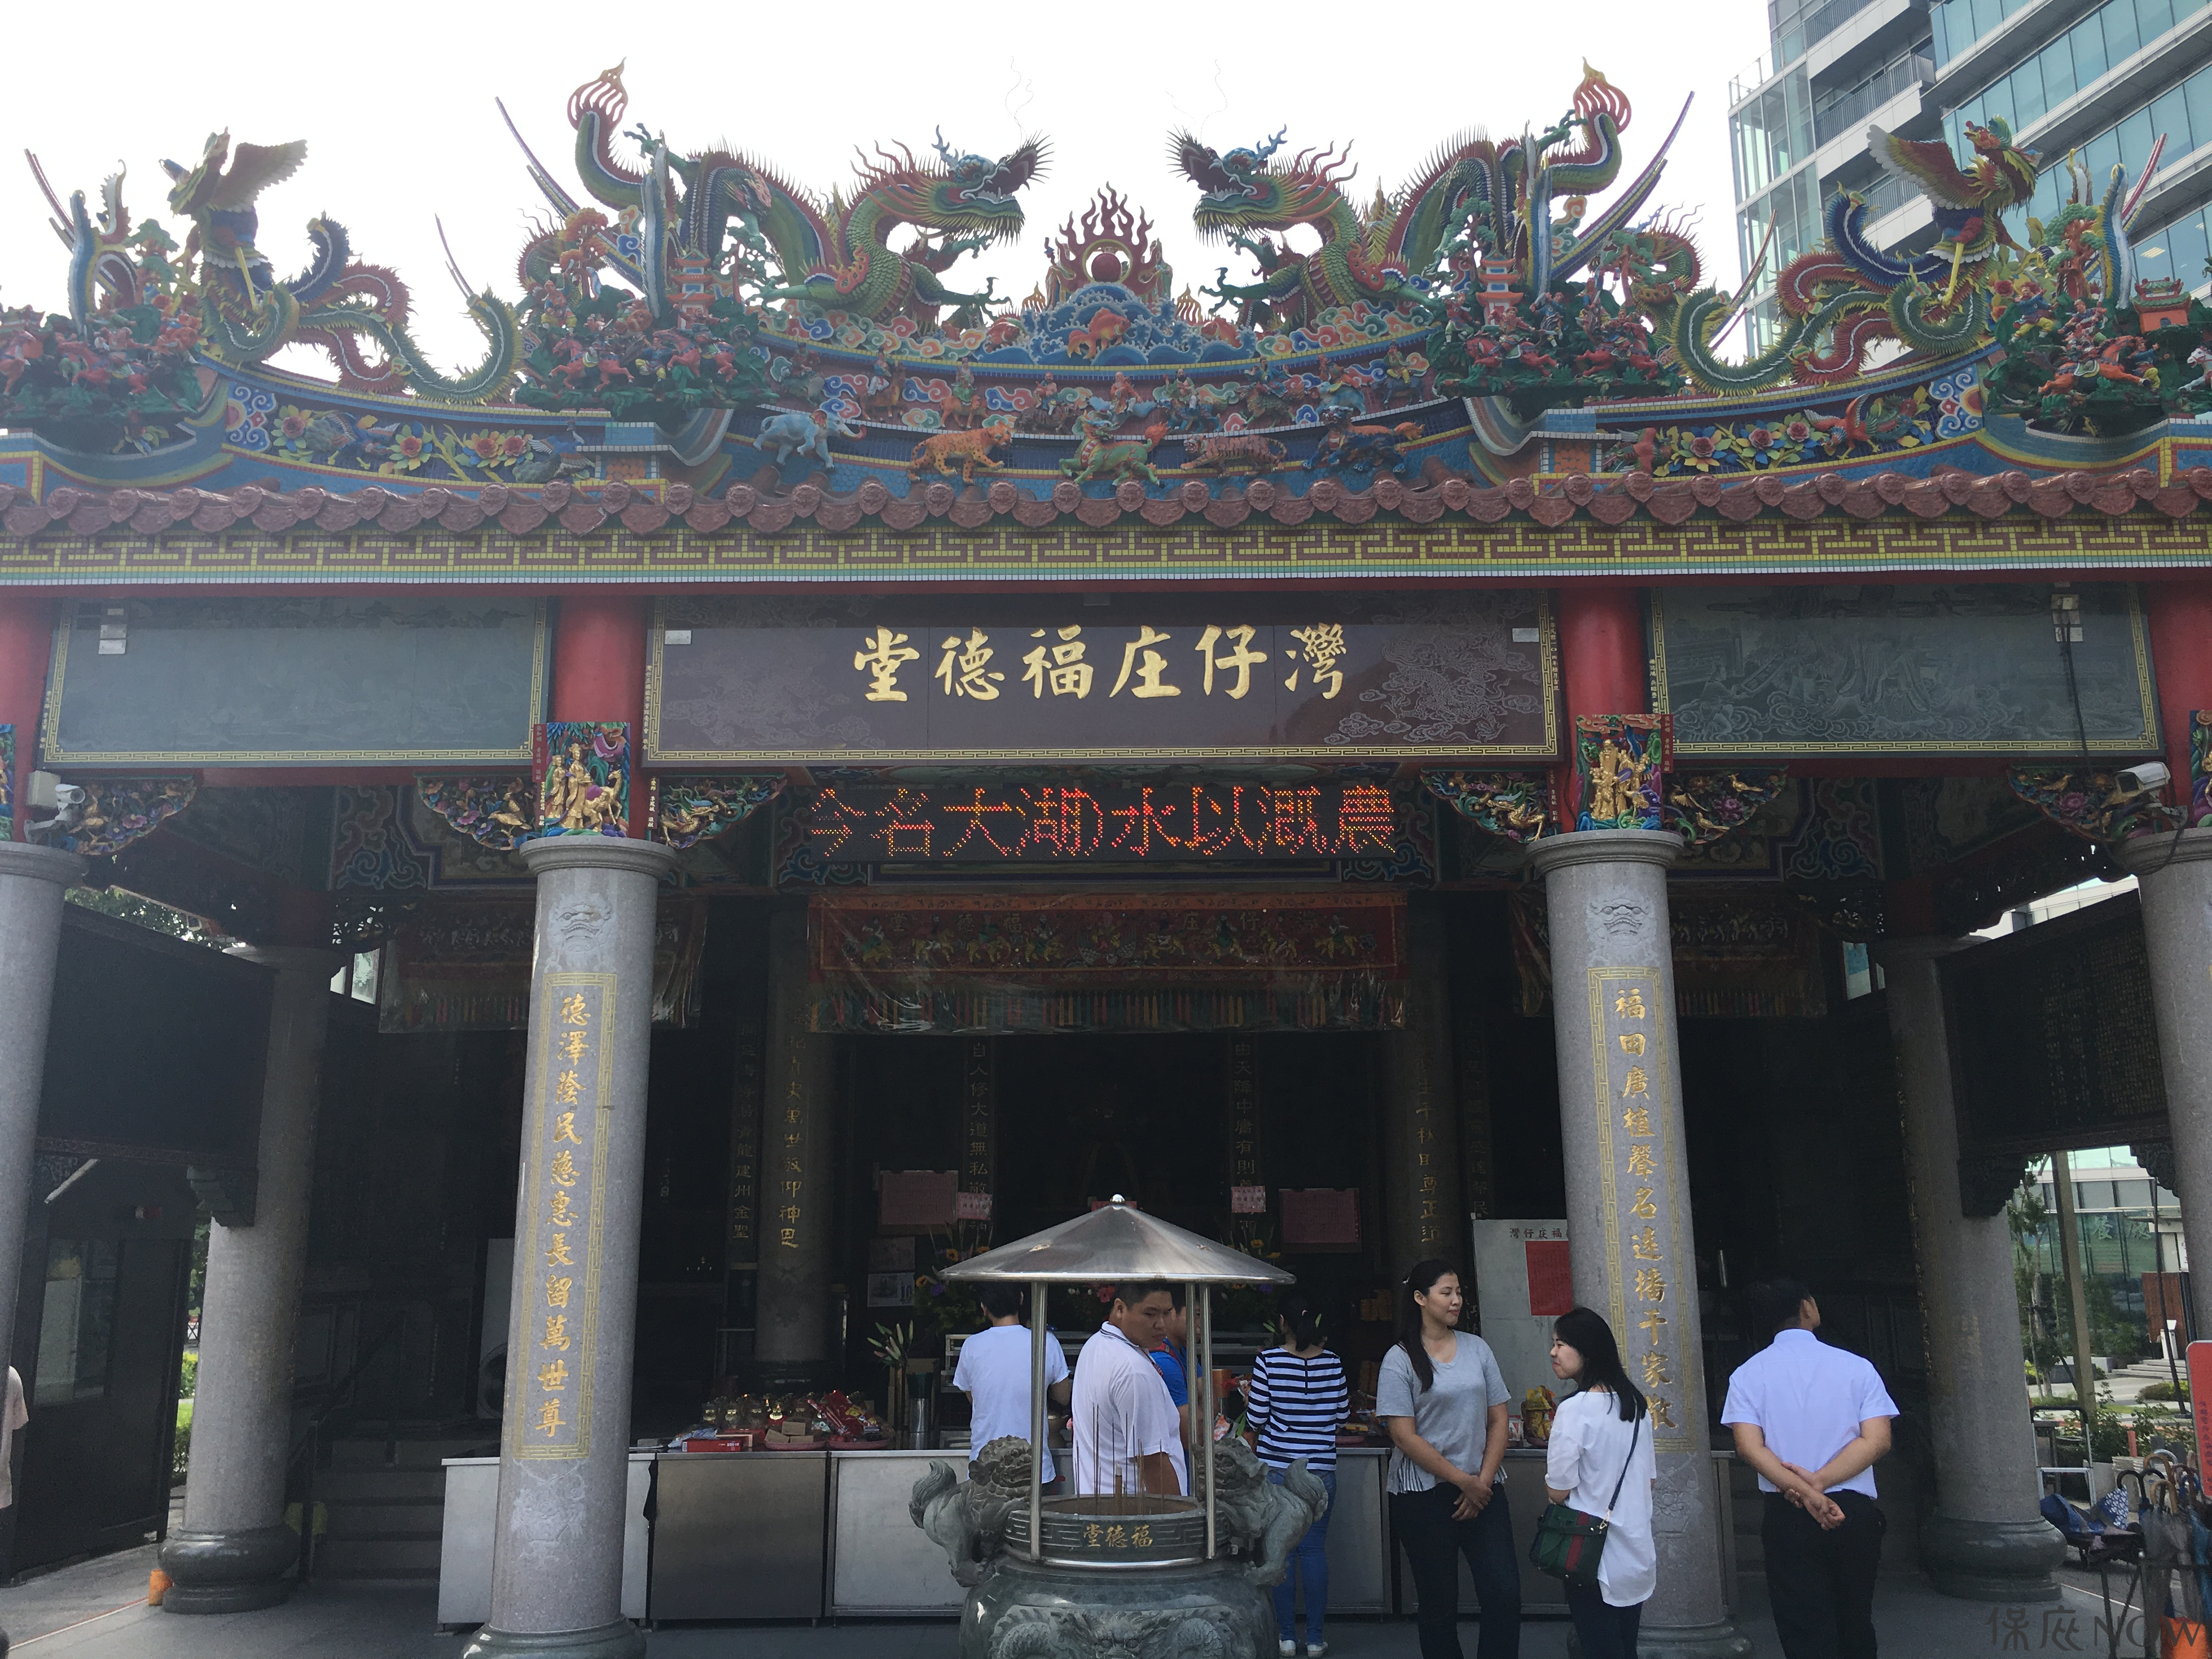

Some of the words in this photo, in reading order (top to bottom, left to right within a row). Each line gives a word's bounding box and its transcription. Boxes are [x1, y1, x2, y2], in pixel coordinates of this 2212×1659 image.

[854, 623, 1347, 702] 灣仔庄福德堂
[1509, 1227, 1568, 1239] 灣仔庄福
[1083, 1525, 1153, 1548] 福德堂
